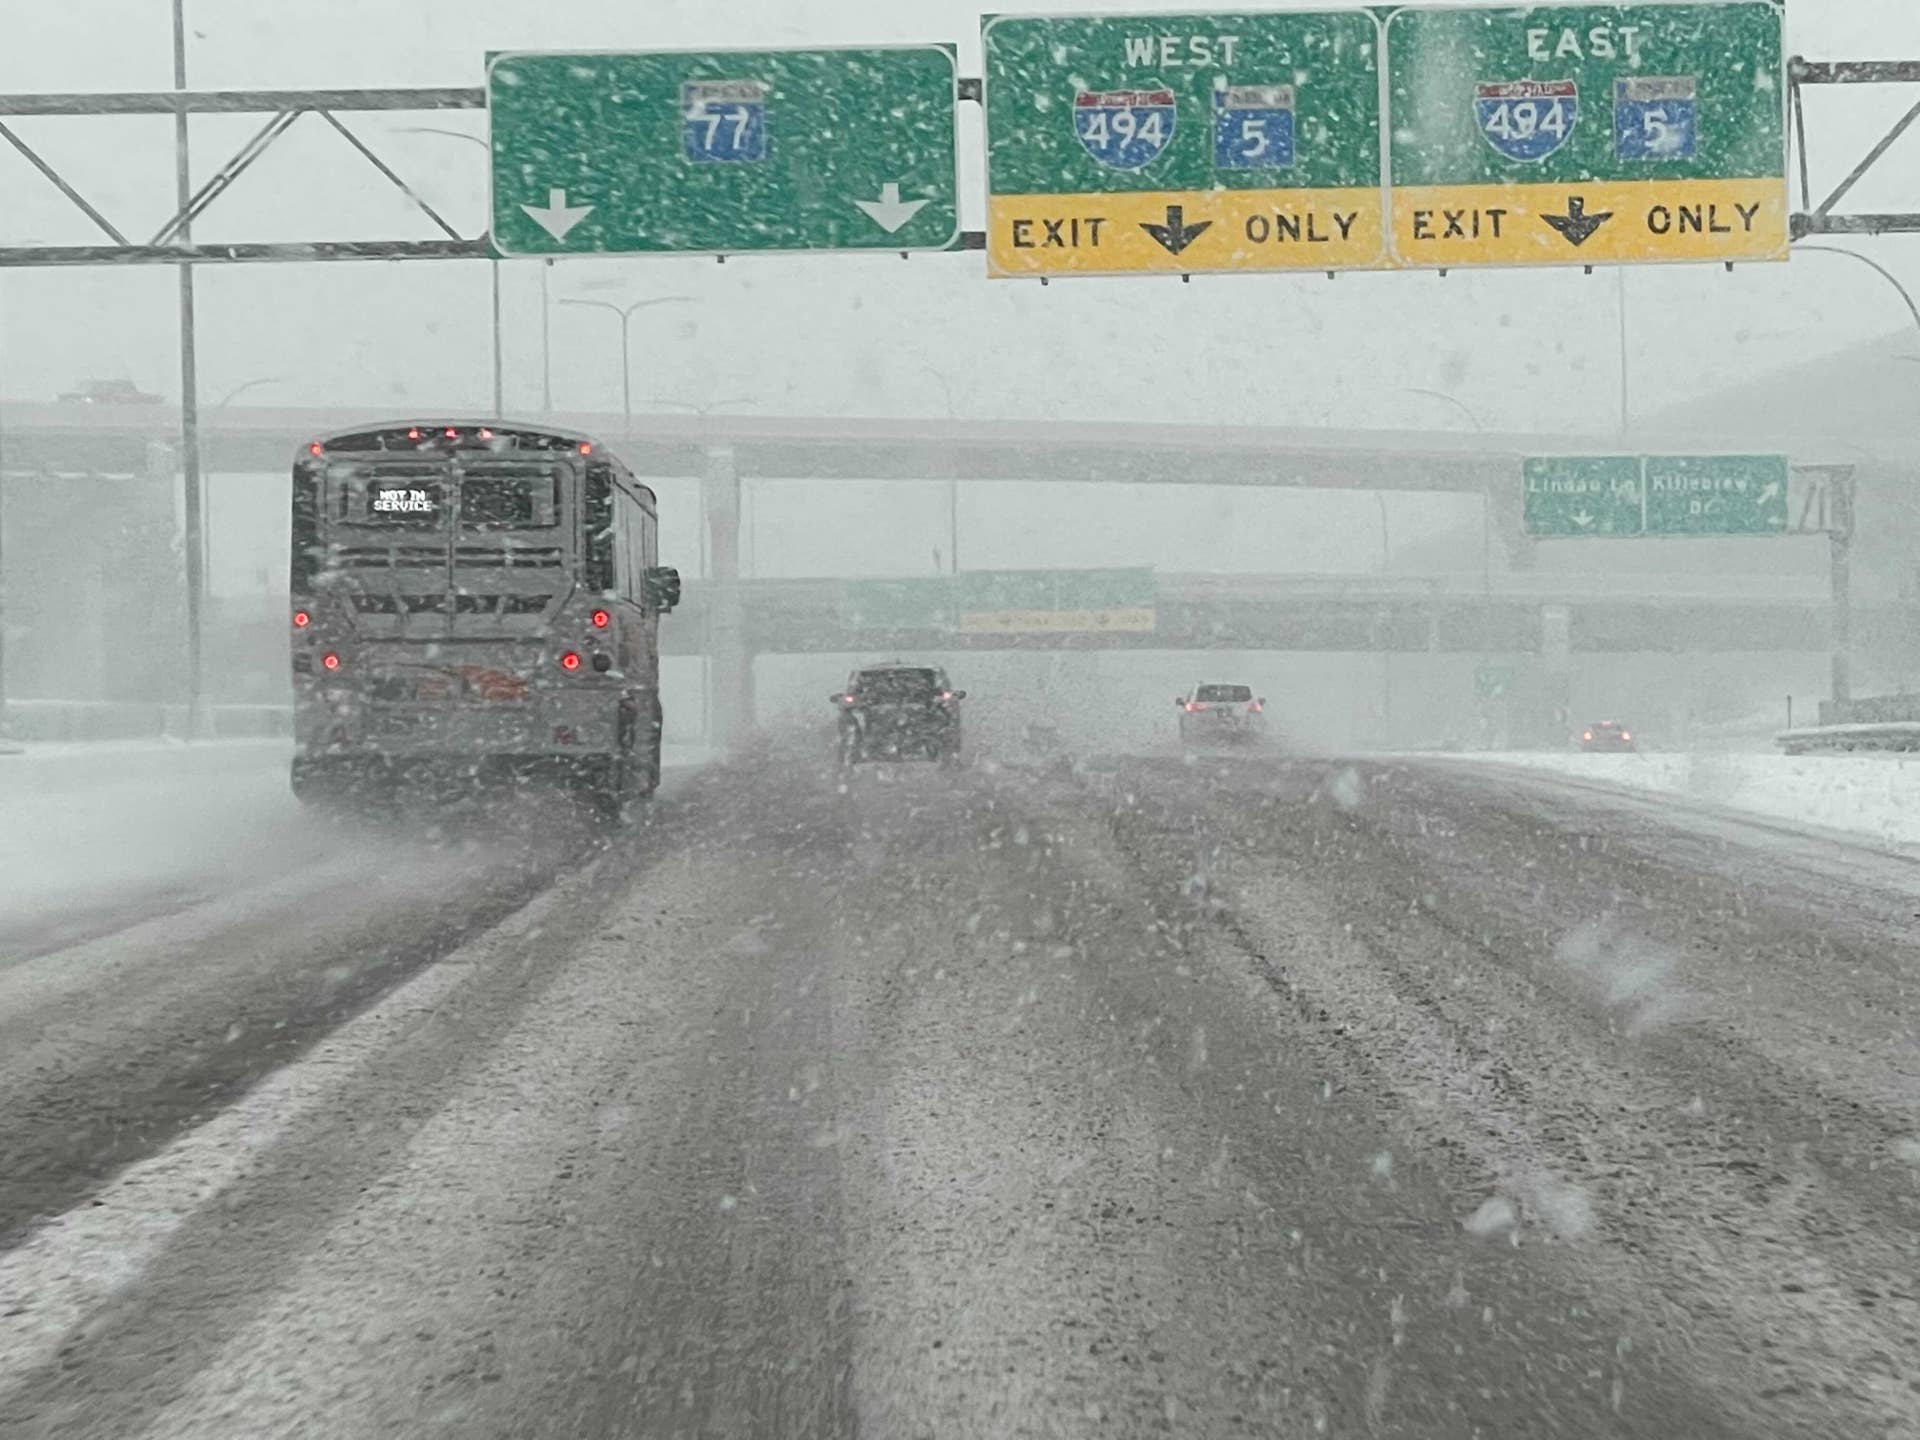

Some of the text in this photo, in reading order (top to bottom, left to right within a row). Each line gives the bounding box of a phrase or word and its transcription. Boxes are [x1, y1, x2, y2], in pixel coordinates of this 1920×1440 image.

[1125, 36, 1240, 67] WEST
[1526, 26, 1639, 60] EAST
[690, 110, 749, 151] 77
[1082, 110, 1164, 150] 494
[1241, 119, 1268, 158] 5
[1485, 101, 1566, 140] 494
[1643, 108, 1668, 149] 5
[1012, 211, 1359, 249] EXIT ONLY
[1413, 201, 1760, 240] EXIT ONLY
[373, 500, 433, 512] SERVICE
[379, 489, 426, 501] NOT IN
